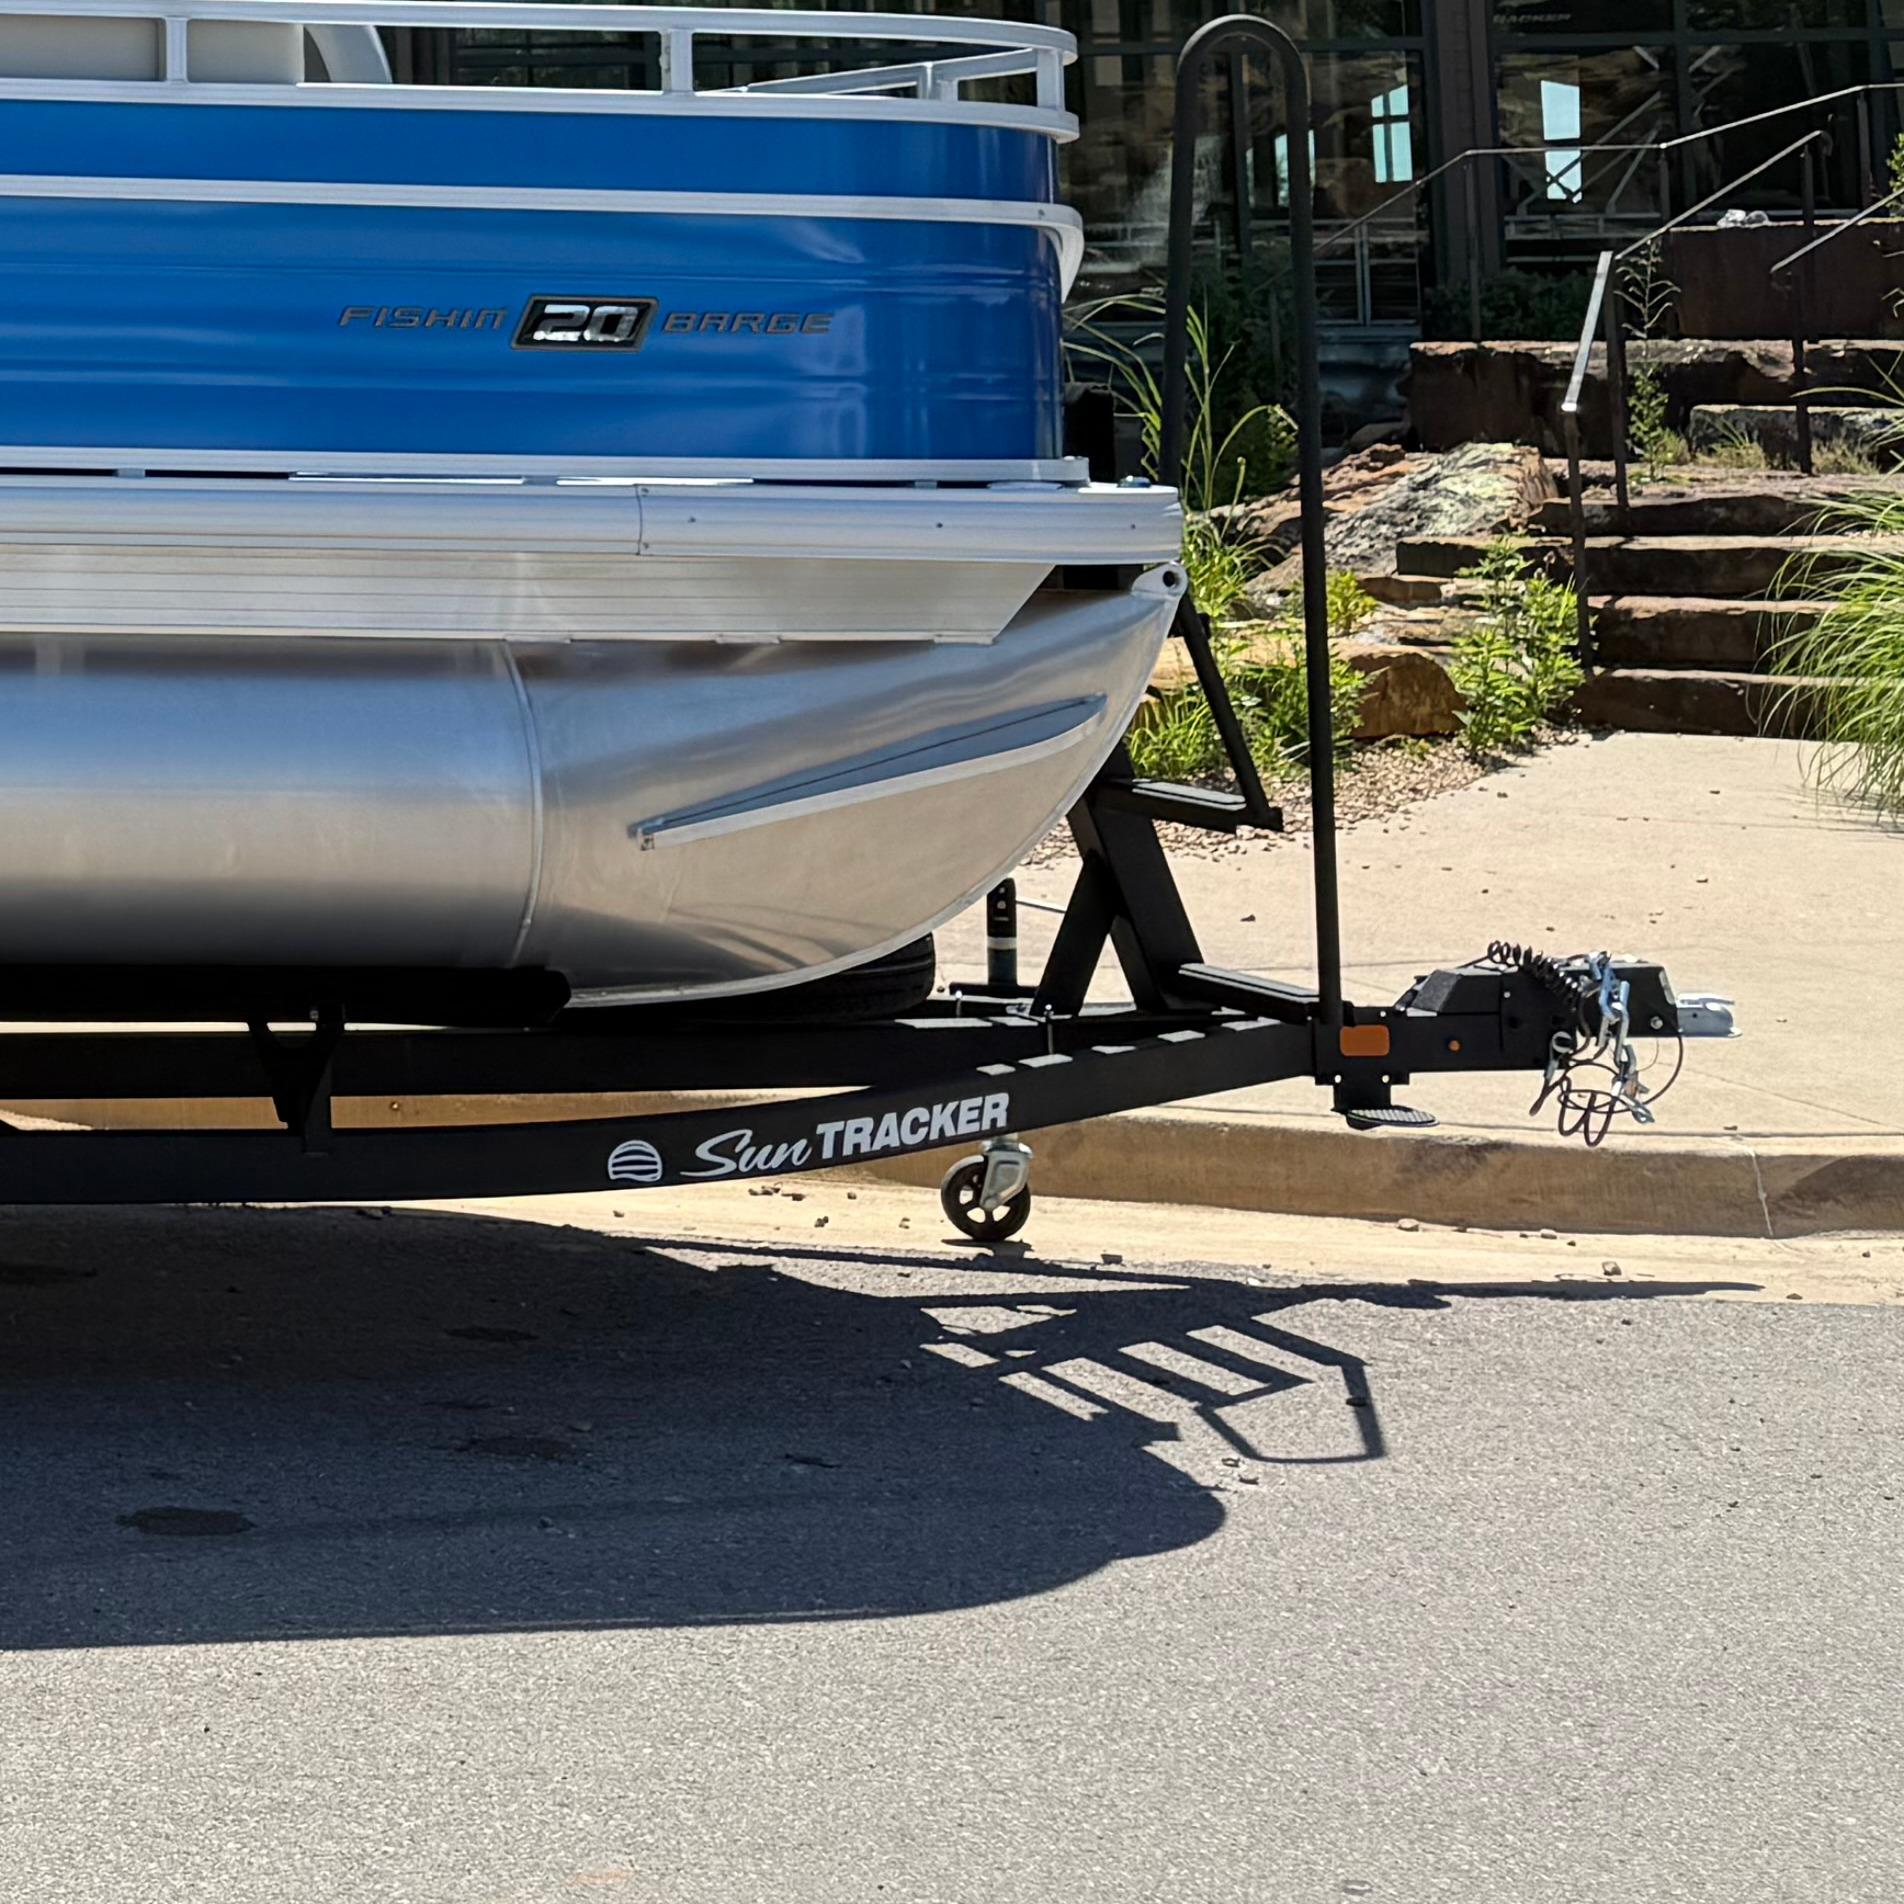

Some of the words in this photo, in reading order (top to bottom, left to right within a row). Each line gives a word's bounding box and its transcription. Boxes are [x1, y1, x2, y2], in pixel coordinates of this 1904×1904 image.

[532, 304, 640, 342] 20
[663, 312, 835, 334] BARGE
[679, 1129, 814, 1178] Sun
[815, 1093, 1009, 1160] TRACKER
